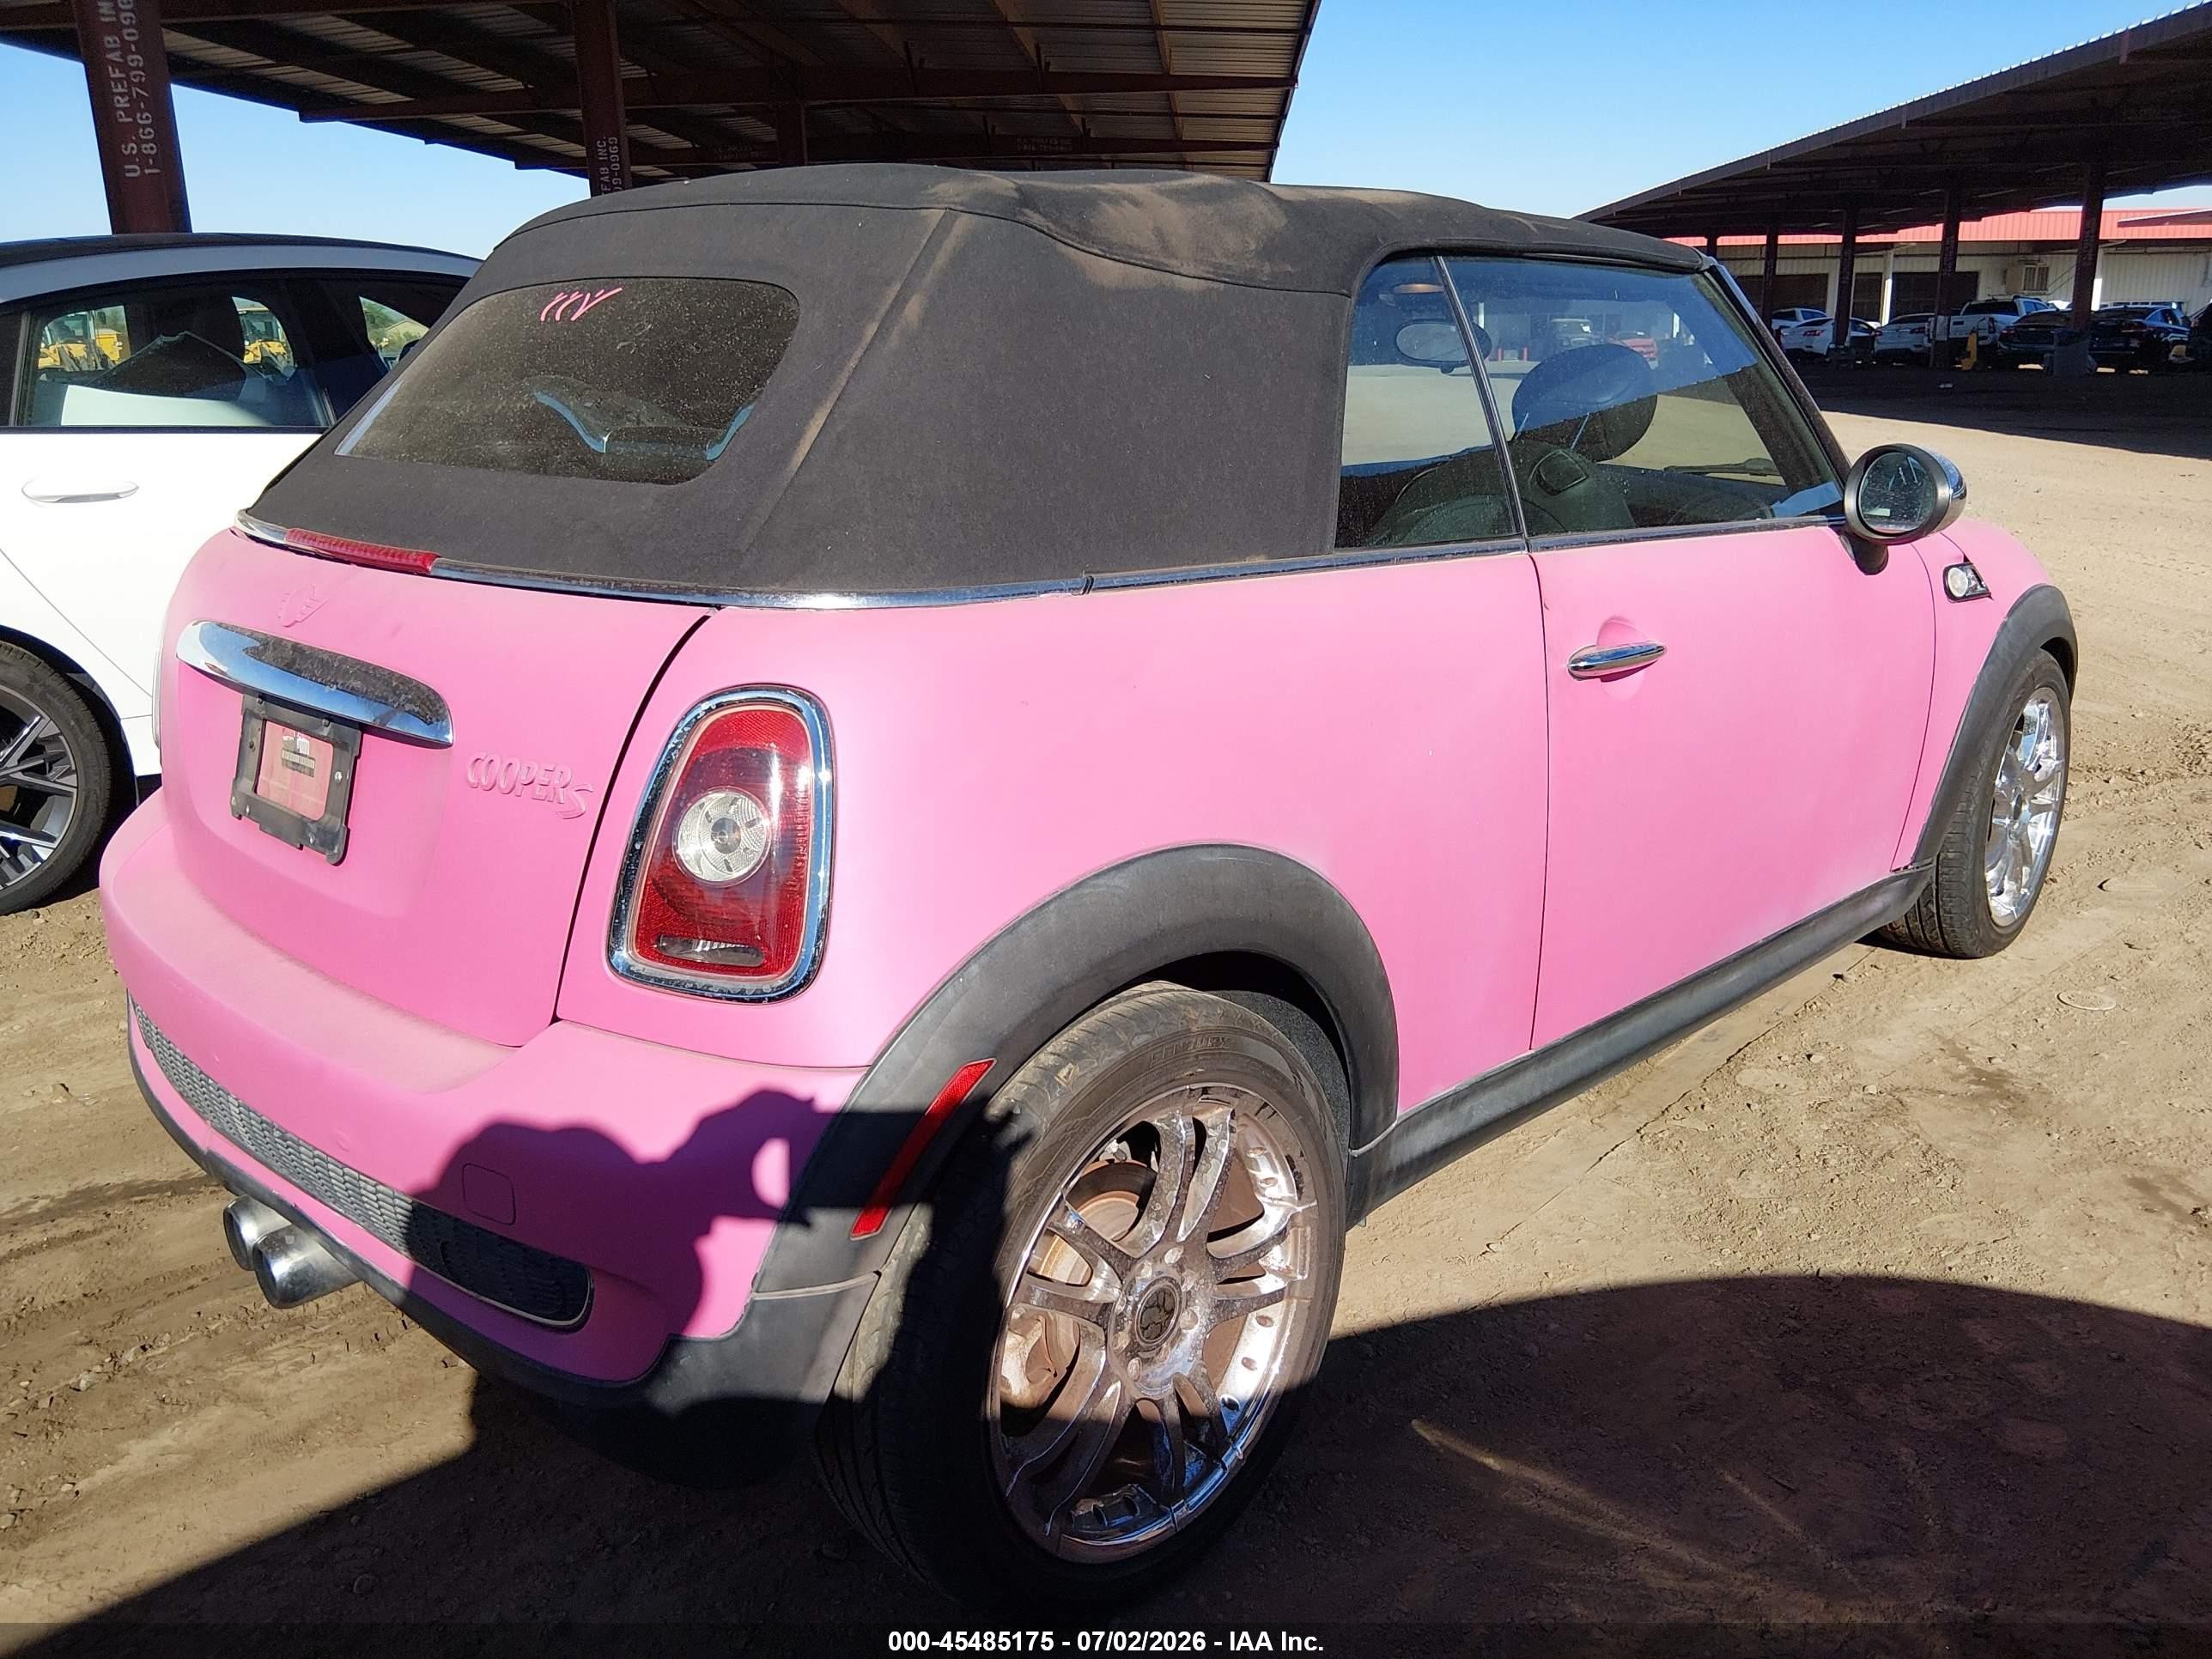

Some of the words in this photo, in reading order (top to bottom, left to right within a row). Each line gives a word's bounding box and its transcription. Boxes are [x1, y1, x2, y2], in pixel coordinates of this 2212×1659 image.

[104, 34, 134, 123] PREFAB
[121, 135, 141, 178] U.S.
[596, 137, 609, 161] INC.
[599, 167, 612, 197] FAB
[466, 750, 573, 805] COOPER
[555, 782, 595, 820] S
